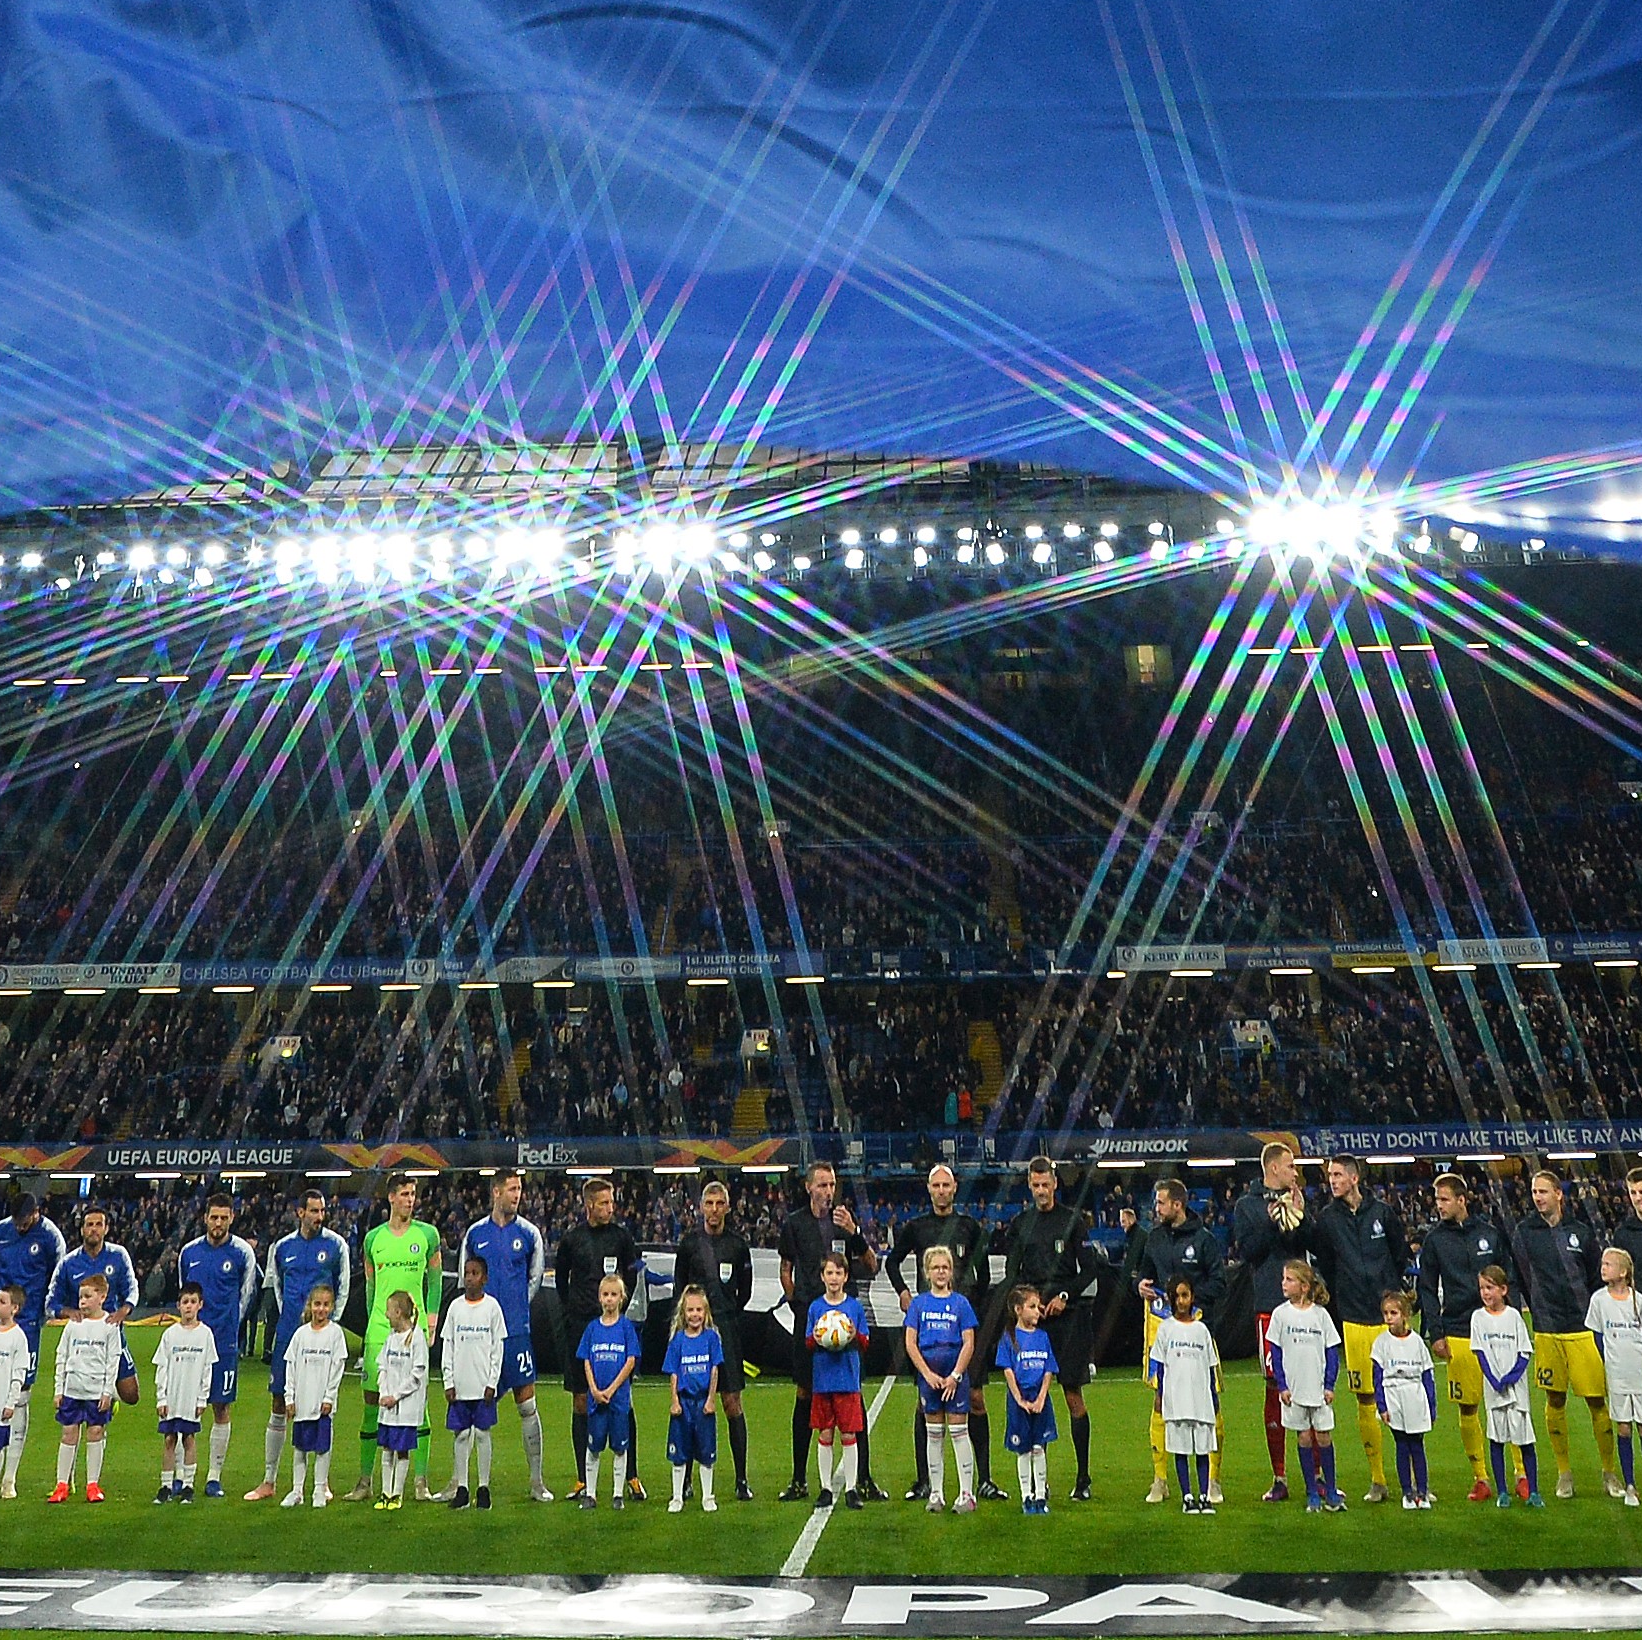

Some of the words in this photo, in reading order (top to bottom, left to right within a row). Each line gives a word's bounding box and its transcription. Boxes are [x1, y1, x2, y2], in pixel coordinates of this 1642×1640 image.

[183, 966, 248, 981] CHELSEA
[252, 965, 325, 980] FOOTBALL
[330, 964, 371, 979] CLUB
[1340, 1133, 1381, 1149] THEY
[1387, 1131, 1439, 1149] DON'T
[1443, 1130, 1491, 1147] MAKE
[1494, 1129, 1540, 1146] THEM
[1544, 1128, 1577, 1145] LIKE
[1582, 1128, 1613, 1144] RAY
[107, 1149, 152, 1165] UEFA
[156, 1149, 222, 1165] EUROPA
[226, 1148, 293, 1165] LEAGUE
[517, 1142, 578, 1165] FedEx
[516, 1350, 534, 1374] 24
[223, 1369, 236, 1390] 17
[1347, 1371, 1362, 1390] 13
[1536, 1367, 1554, 1386] 42
[1449, 1380, 1463, 1400] 15
